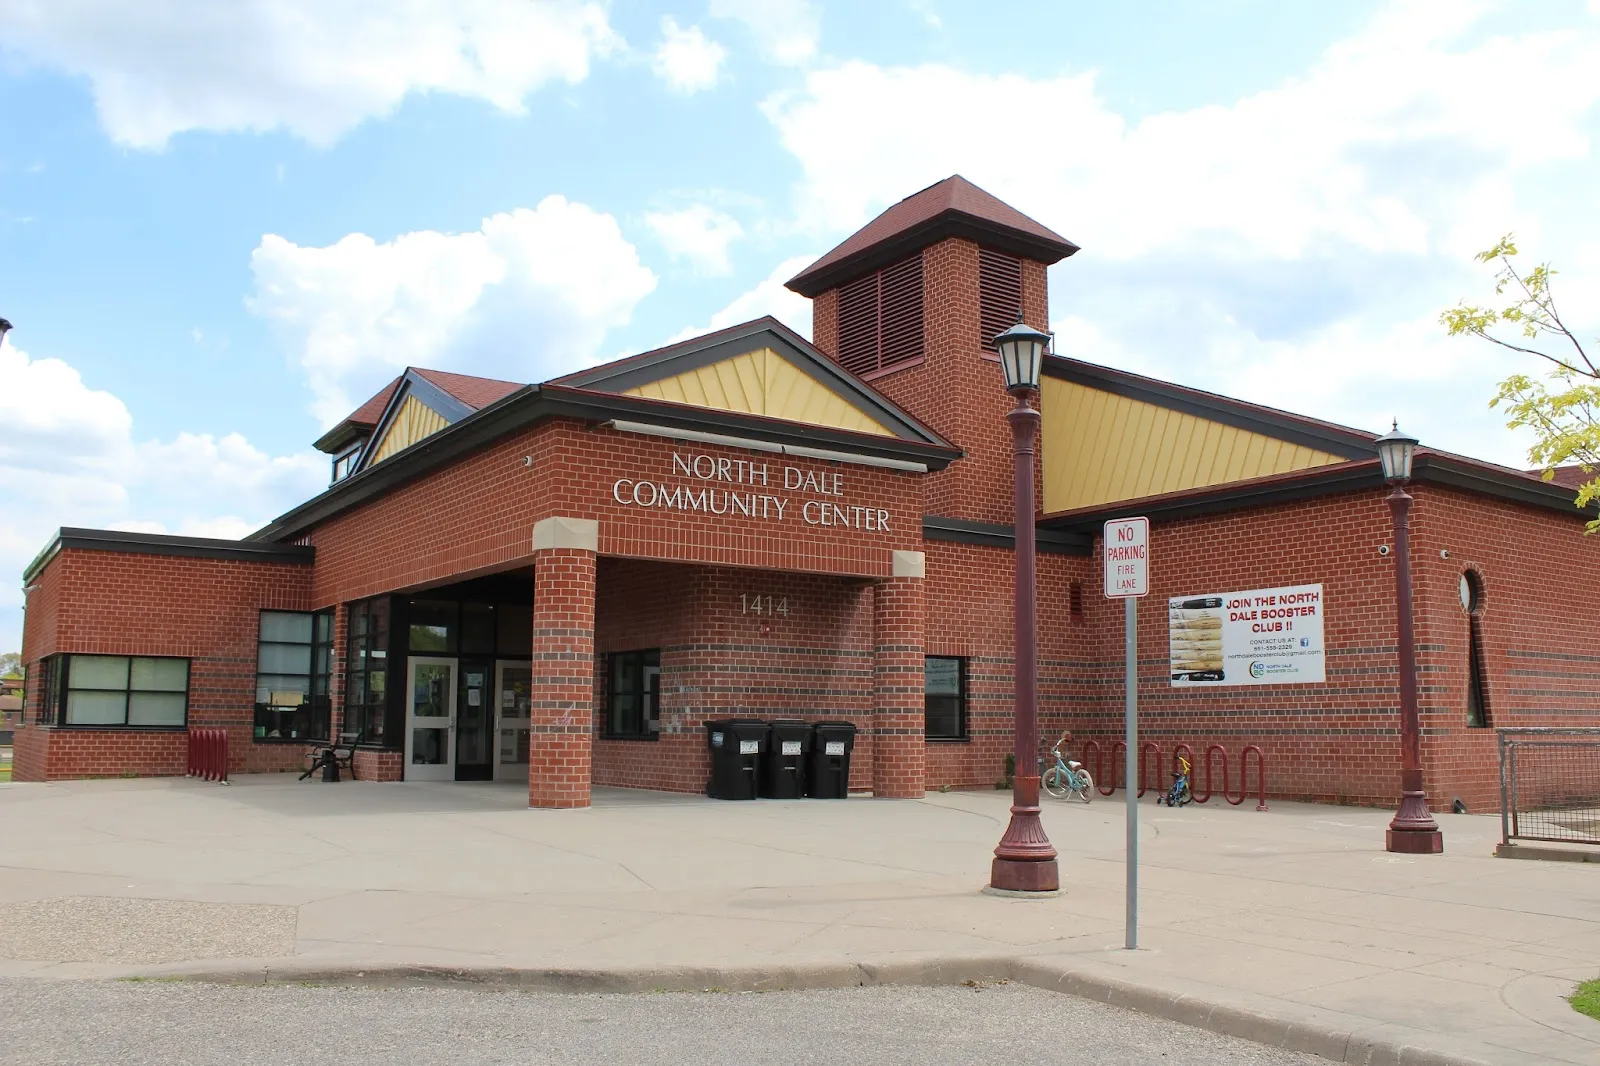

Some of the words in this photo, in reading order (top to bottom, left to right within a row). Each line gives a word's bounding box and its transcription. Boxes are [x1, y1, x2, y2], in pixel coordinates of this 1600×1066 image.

[672, 451, 767, 486] NORTH
[784, 466, 844, 496] DALE
[613, 479, 789, 520] COMMUNITY
[803, 501, 890, 531] CENTER
[1118, 527, 1134, 542] NO
[1108, 545, 1145, 561] PARKING
[1117, 564, 1135, 575] FIRE
[1116, 579, 1136, 589] LANE
[740, 593, 789, 617] 1414
[1226, 598, 1252, 609] JOIN
[1255, 596, 1276, 607] THE
[1279, 592, 1319, 605] NORTH
[1230, 610, 1258, 622] DALE
[1261, 606, 1316, 619] BOOSTER
[1252, 622, 1283, 633] CLUB
[1286, 621, 1293, 631] !!
[1228, 650, 1321, 659] northdaleboosterclub@gmail.com
